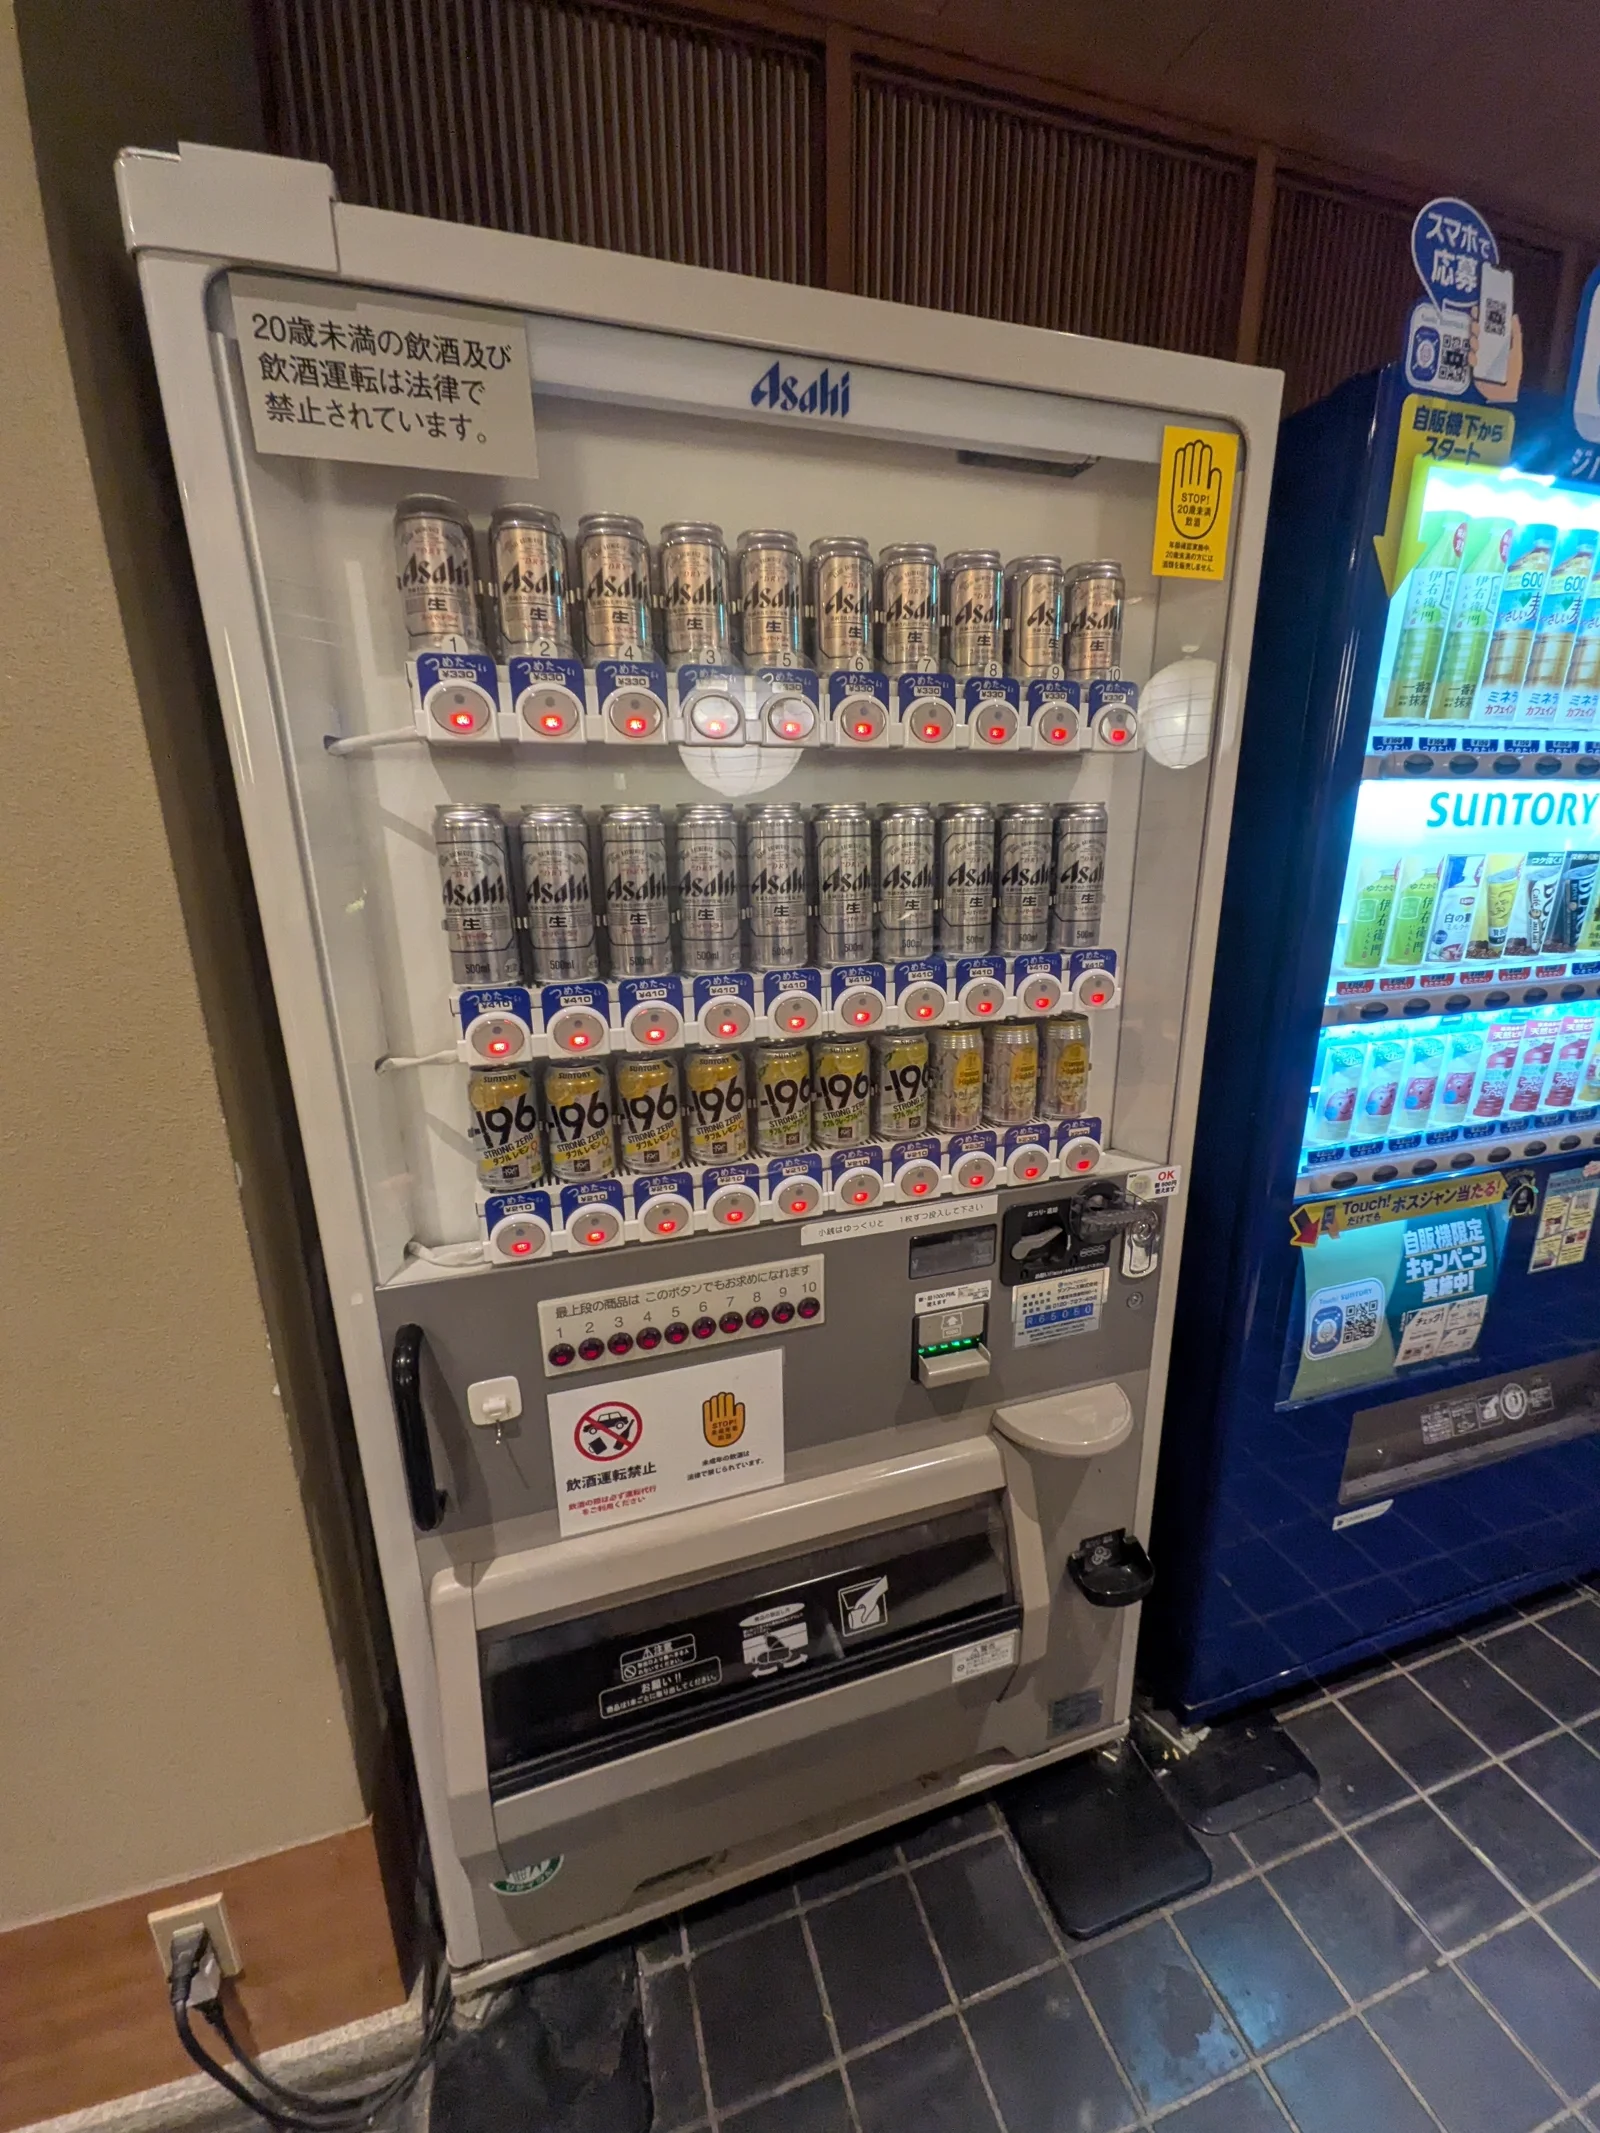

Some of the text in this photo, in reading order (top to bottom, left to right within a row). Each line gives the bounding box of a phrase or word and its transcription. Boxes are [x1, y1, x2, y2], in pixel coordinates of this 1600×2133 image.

[1426, 213, 1491, 258] スマホで
[1431, 250, 1477, 293] 応募
[252, 314, 511, 369] 20歳未満の飲酒及び
[261, 352, 485, 405] 飲酒運転は法律で
[751, 361, 849, 417] Asahi
[266, 392, 487, 444] 禁止されています。
[1413, 405, 1503, 442] 自販機下から
[1423, 437, 1480, 465] スタート
[1182, 493, 1210, 505] STOP!
[1177, 505, 1211, 517] 20歳未満
[1185, 518, 1201, 527] 飲酒
[402, 553, 471, 588] Asahi
[587, 568, 649, 600] Asahi
[1422, 570, 1444, 623] 伊右衛門
[449, 638, 458, 652] 1
[540, 641, 550, 656] 2
[624, 646, 634, 660] 4
[706, 650, 715, 665] 3
[783, 653, 791, 667] 5
[855, 658, 864, 671] 6
[923, 659, 932, 672] 7
[989, 663, 997, 677] 8
[442, 670, 474, 679] ¥330
[533, 673, 563, 682] ¥330
[1052, 667, 1059, 680] 9
[1108, 668, 1120, 681] 10
[618, 677, 646, 686] ¥330
[982, 690, 1003, 698] ¥330
[1427, 792, 1600, 827] SUNTORY
[442, 876, 504, 905] Asahi
[527, 874, 589, 904] Asahi
[607, 872, 667, 900] Asahi
[679, 870, 736, 898] Asahi
[846, 903, 860, 914] 生
[905, 900, 919, 910] 生
[970, 898, 983, 907] 生
[1022, 897, 1037, 906] 生
[698, 909, 714, 921] 生
[774, 906, 789, 917] 生
[462, 918, 481, 931] 生
[549, 916, 568, 928] 生
[629, 914, 648, 925] 生
[1370, 899, 1391, 957] 伊右衛門
[712, 986, 736, 994] ¥410
[782, 981, 806, 989] ¥410
[563, 996, 591, 1004] ¥410
[638, 989, 665, 998] ¥410
[629, 1064, 660, 1072] SUNTORY
[700, 1057, 729, 1065] SUNTORY
[483, 1074, 516, 1083] SUNTORY
[893, 1098, 920, 1112] STRONG
[769, 1114, 797, 1127] STRONG
[823, 1107, 850, 1120] STRONG
[696, 1113, 742, 1135] STRONG ZERO
[628, 1121, 675, 1143] STRONG ZERO
[484, 1133, 534, 1159] STRONG ZERO
[557, 1129, 605, 1153] STRONG ZERO
[1158, 1170, 1175, 1180] OK
[1343, 1181, 1501, 1215] Touch! ボスジャン当たる!
[1347, 1213, 1381, 1226] だけでも
[818, 1219, 884, 1237] 小銭はゆっくりと
[1403, 1218, 1485, 1254] 自販機限定
[1405, 1246, 1487, 1281] キャンペーン
[1423, 1270, 1474, 1297] 実施中!
[555, 1265, 810, 1319] 最上段の商品は このボタンでもお求めになれます
[556, 1282, 817, 1338] 1 2 3 4 5 6 7 8 9 10
[712, 1419, 737, 1429] STOP!
[566, 1461, 656, 1492] 飲酒運転禁止
